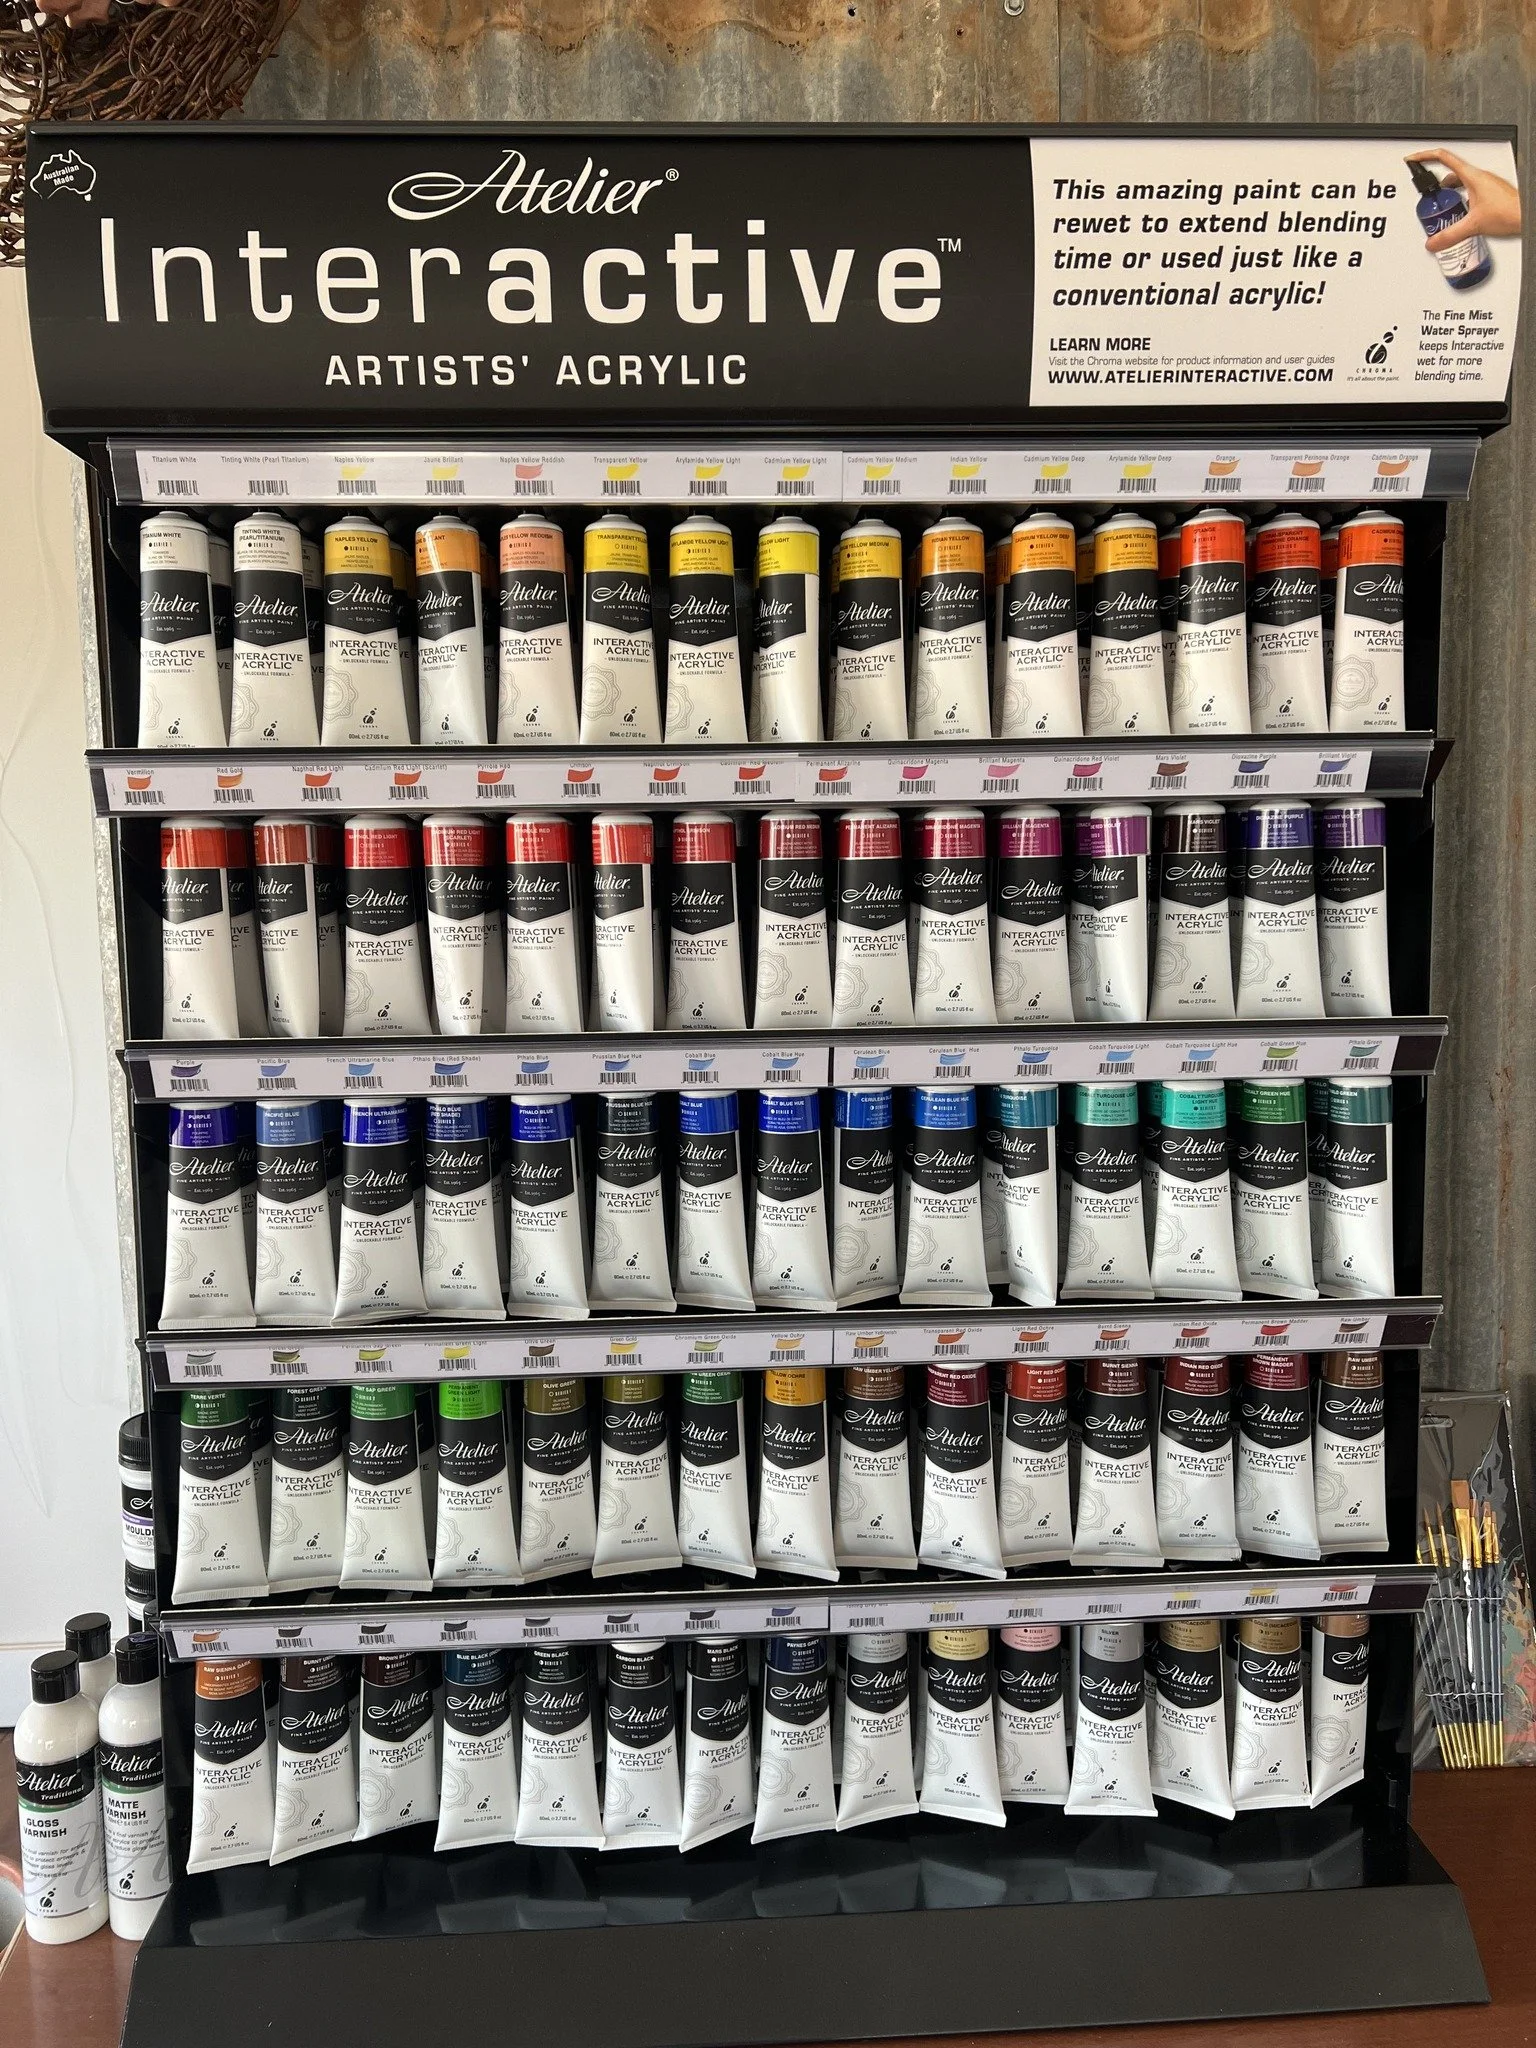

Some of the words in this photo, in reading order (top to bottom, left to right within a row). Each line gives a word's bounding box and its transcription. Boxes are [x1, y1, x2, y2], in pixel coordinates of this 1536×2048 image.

[43, 165, 79, 180] Australian
[53, 175, 74, 185] Made
[1053, 179, 1105, 199] This
[1116, 179, 1223, 205] amazing
[1233, 179, 1300, 205] paint
[1311, 184, 1356, 199] can
[1367, 179, 1396, 199] be
[1053, 214, 1130, 233] rewet
[1142, 214, 1168, 233] to
[1179, 211, 1268, 233] extend
[1278, 211, 1387, 238] blending
[1054, 247, 1111, 268] time
[1122, 253, 1150, 268] or
[1161, 246, 1223, 268] used
[1229, 247, 1283, 273] just
[1293, 245, 1337, 267] like
[1348, 251, 1362, 267] a
[1053, 281, 1220, 306] conventional
[1229, 281, 1326, 311] acrylic!
[1423, 310, 1440, 320] The
[1444, 310, 1465, 320] Fine
[1469, 310, 1493, 320] Mist
[1421, 326, 1454, 335] Water
[1458, 325, 1499, 338] Sprayer
[1050, 338, 1100, 351] LEARN
[1106, 338, 1150, 350] MORE
[1419, 341, 1448, 353] keeps
[1451, 340, 1504, 350] Interactive
[1049, 356, 1068, 365] Visit
[1070, 356, 1085, 365] the
[1087, 356, 1122, 365] Chroma
[1125, 356, 1158, 365] website
[1161, 356, 1174, 365] for
[1176, 356, 1211, 367] product
[1213, 355, 1262, 364] information
[1266, 355, 1282, 364] and
[1285, 356, 1304, 364] user
[1306, 355, 1335, 366] guides
[1417, 357, 1435, 365] wet
[1439, 356, 1453, 365] for
[325, 355, 530, 386] ARTISTS'
[556, 354, 748, 385] ACRYLIC
[1048, 369, 1334, 383] WWW.ATELIERINTERACTIVE.COM
[1415, 371, 1455, 383] blending
[1459, 371, 1483, 380] time.
[327, 582, 393, 605] Atelier
[329, 640, 398, 651] INTERACTIVE
[340, 648, 391, 657] ACRYLIC
[921, 867, 982, 887] Atelier
[921, 918, 986, 929] INTERACTIVE
[929, 927, 977, 937] ACRYLIC
[1162, 1136, 1226, 1155] Atelier
[1161, 1185, 1228, 1195] INTERACTIVE
[1172, 1192, 1220, 1203] ACRYLIC
[1168, 1407, 1232, 1426] Atelier
[274, 1426, 337, 1446] Atelier
[1167, 1452, 1232, 1465] INTERACTIVE
[1178, 1461, 1225, 1471] ACRYLIC
[275, 1468, 342, 1485] INTERACTIVE
[284, 1479, 333, 1492] ACRYLIC
[616, 1654, 636, 1662] CARBON
[524, 1690, 585, 1708] Atelier
[524, 1733, 588, 1745] INTERACTIVE
[533, 1743, 579, 1753] ACRYLIC
[121, 1769, 164, 1781] Traditional
[41, 1785, 84, 1801] Traditional
[108, 1798, 139, 1809] MATTE
[105, 1811, 146, 1819] VARNISH
[24, 1828, 67, 1838] VARNISH
